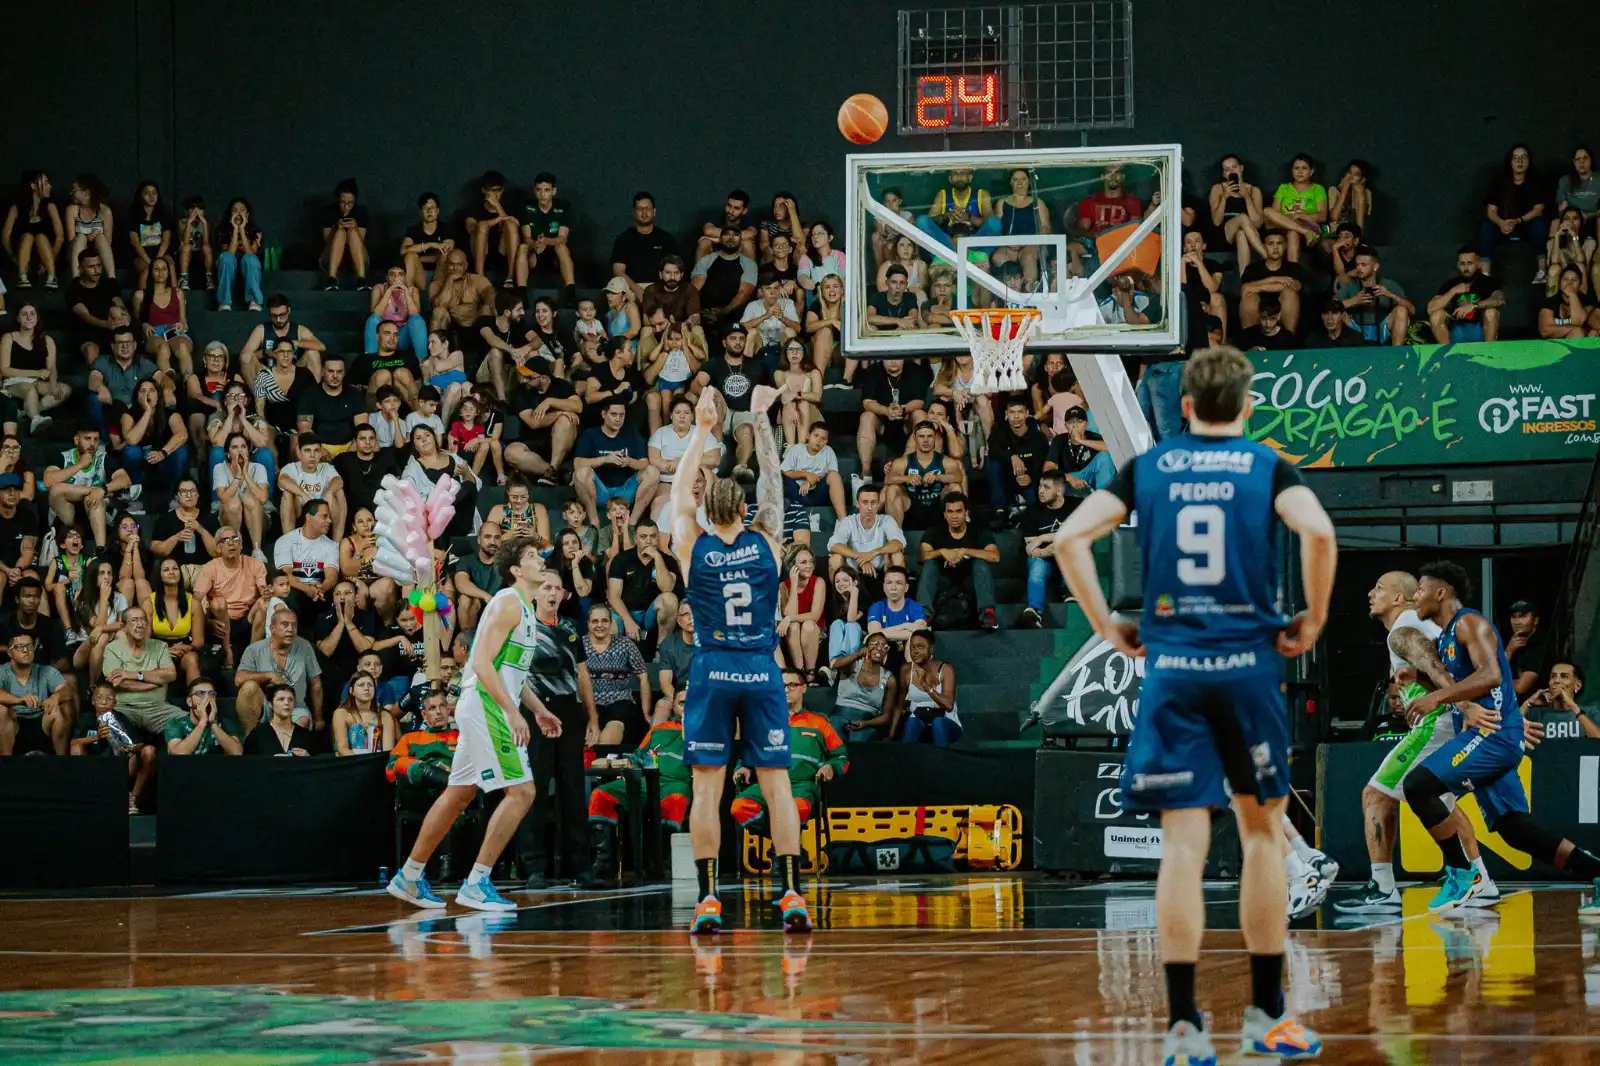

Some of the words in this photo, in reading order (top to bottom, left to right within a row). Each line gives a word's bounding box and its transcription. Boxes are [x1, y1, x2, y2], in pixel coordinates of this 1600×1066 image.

[916, 75, 997, 127] 24
[1431, 383, 1458, 441] É
[1522, 393, 1596, 420] FAST
[1522, 420, 1597, 434] INGRESSOS
[1169, 481, 1235, 502] PEDRO
[1176, 504, 1226, 586] 9
[719, 569, 749, 582] LEAL
[722, 582, 753, 626] 2
[708, 670, 769, 683] MILCLEAN
[1110, 834, 1147, 843] Unimed
